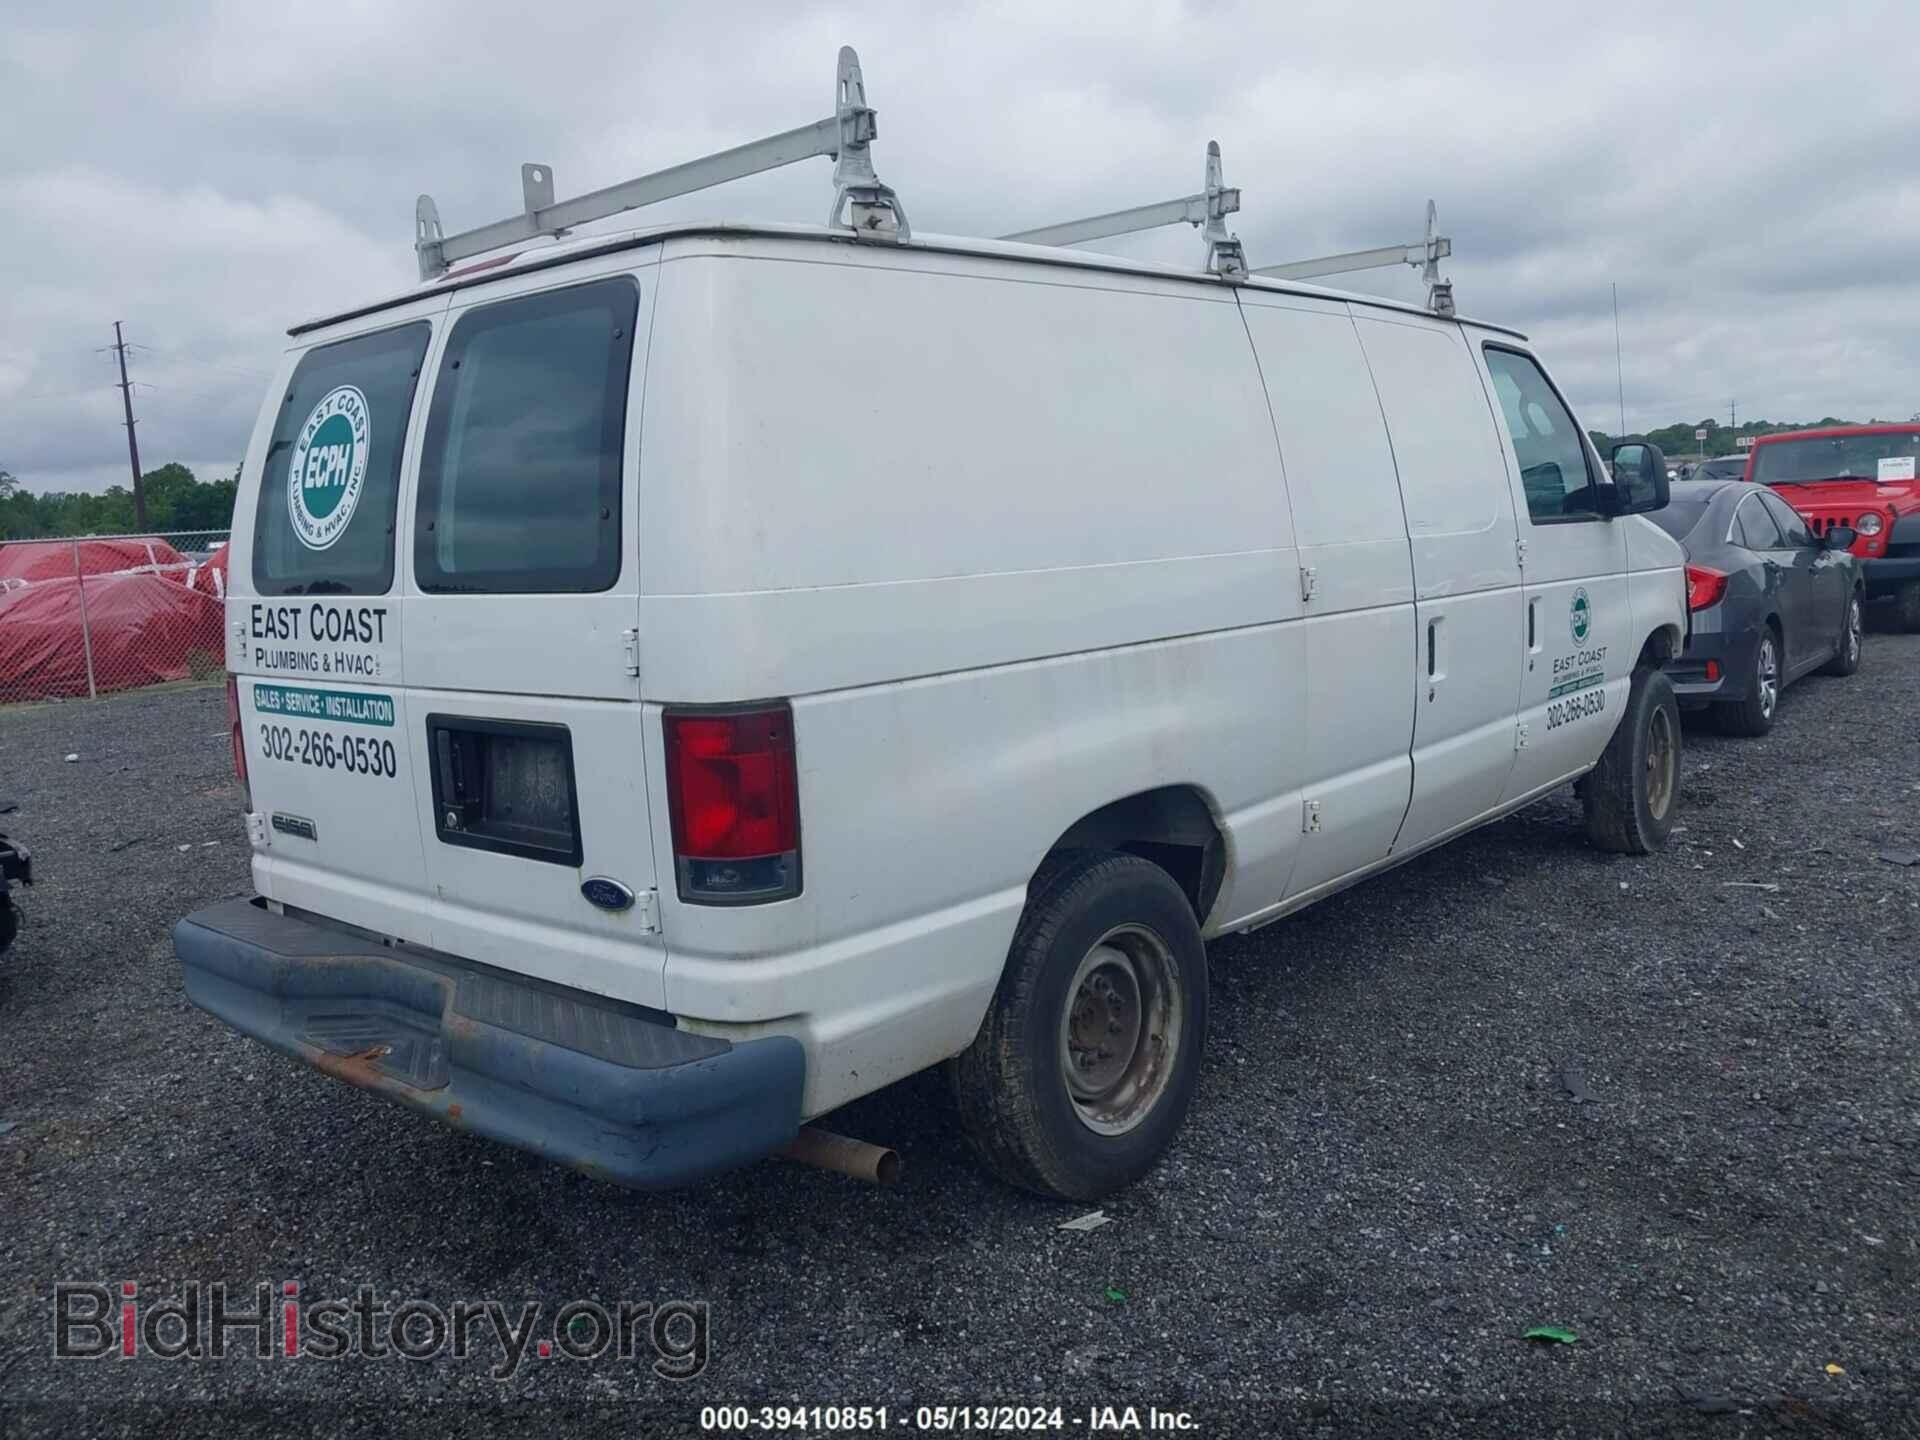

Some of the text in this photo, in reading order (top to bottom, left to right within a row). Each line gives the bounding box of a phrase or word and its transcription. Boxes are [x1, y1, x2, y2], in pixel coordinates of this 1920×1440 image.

[299, 394, 366, 454] EAST COAST
[304, 444, 351, 489] ECPH
[292, 467, 314, 538] PLUMBING
[251, 603, 387, 644] EAST COAST
[255, 648, 374, 675] PLUMBING & HVAC
[1553, 647, 1608, 673] EAST COAST
[255, 689, 393, 722] SALES SERVICE INSTALLATION
[1546, 689, 1606, 731] 302-266-0530
[260, 723, 397, 779] 302-266-0530
